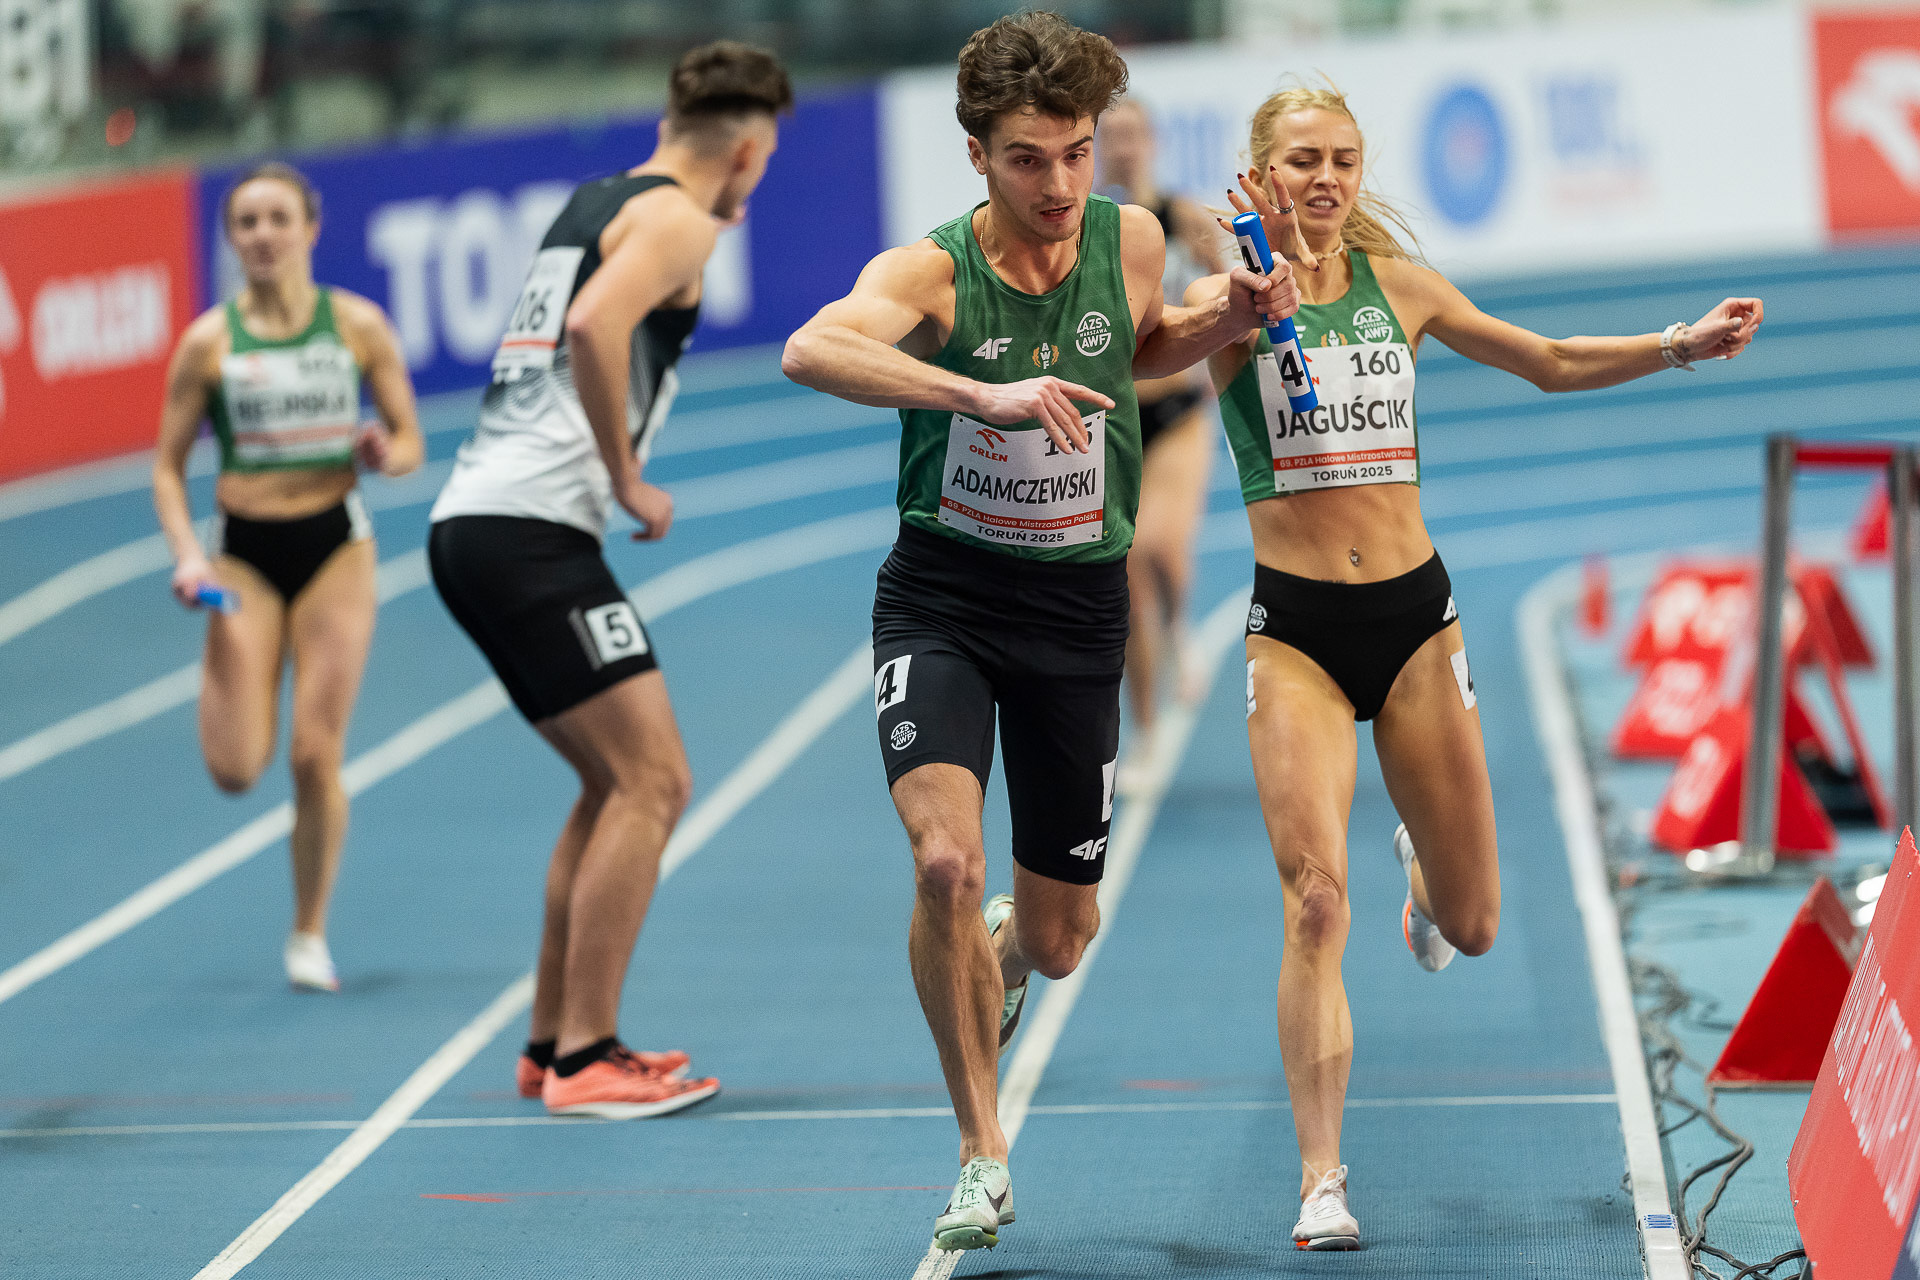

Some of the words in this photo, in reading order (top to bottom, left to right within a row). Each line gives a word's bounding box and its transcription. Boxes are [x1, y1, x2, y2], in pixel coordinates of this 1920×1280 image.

[1082, 318, 1103, 331] AZS
[1360, 312, 1381, 324] AZS
[1082, 334, 1106, 349] AWF
[1364, 327, 1388, 340] AWF
[972, 337, 1013, 360] 4F
[1281, 350, 1305, 388] 4
[1350, 350, 1401, 377] 160
[1276, 395, 1409, 440] JAGUŚCIK
[969, 444, 1009, 463] ORLEN
[1280, 460, 1293, 469] 69.
[1294, 458, 1314, 467] PZLA
[1315, 454, 1346, 464] Halowe
[1346, 450, 1397, 461] Mistrzostwa
[951, 465, 1097, 505] ADAMCZEWSKI
[1312, 466, 1357, 482] TORUŃ
[1360, 465, 1393, 478] 2025
[947, 501, 960, 511] 69.
[962, 507, 982, 520] PZLA
[983, 514, 1018, 526] Halowe
[1019, 518, 1072, 529] Mistrzostwa
[1073, 512, 1098, 524] Polski
[976, 524, 1028, 542] TORUŃ
[1030, 532, 1065, 543] 2025
[606, 611, 633, 649] 5
[877, 662, 898, 708] 4
[1069, 835, 1108, 860] 4F
